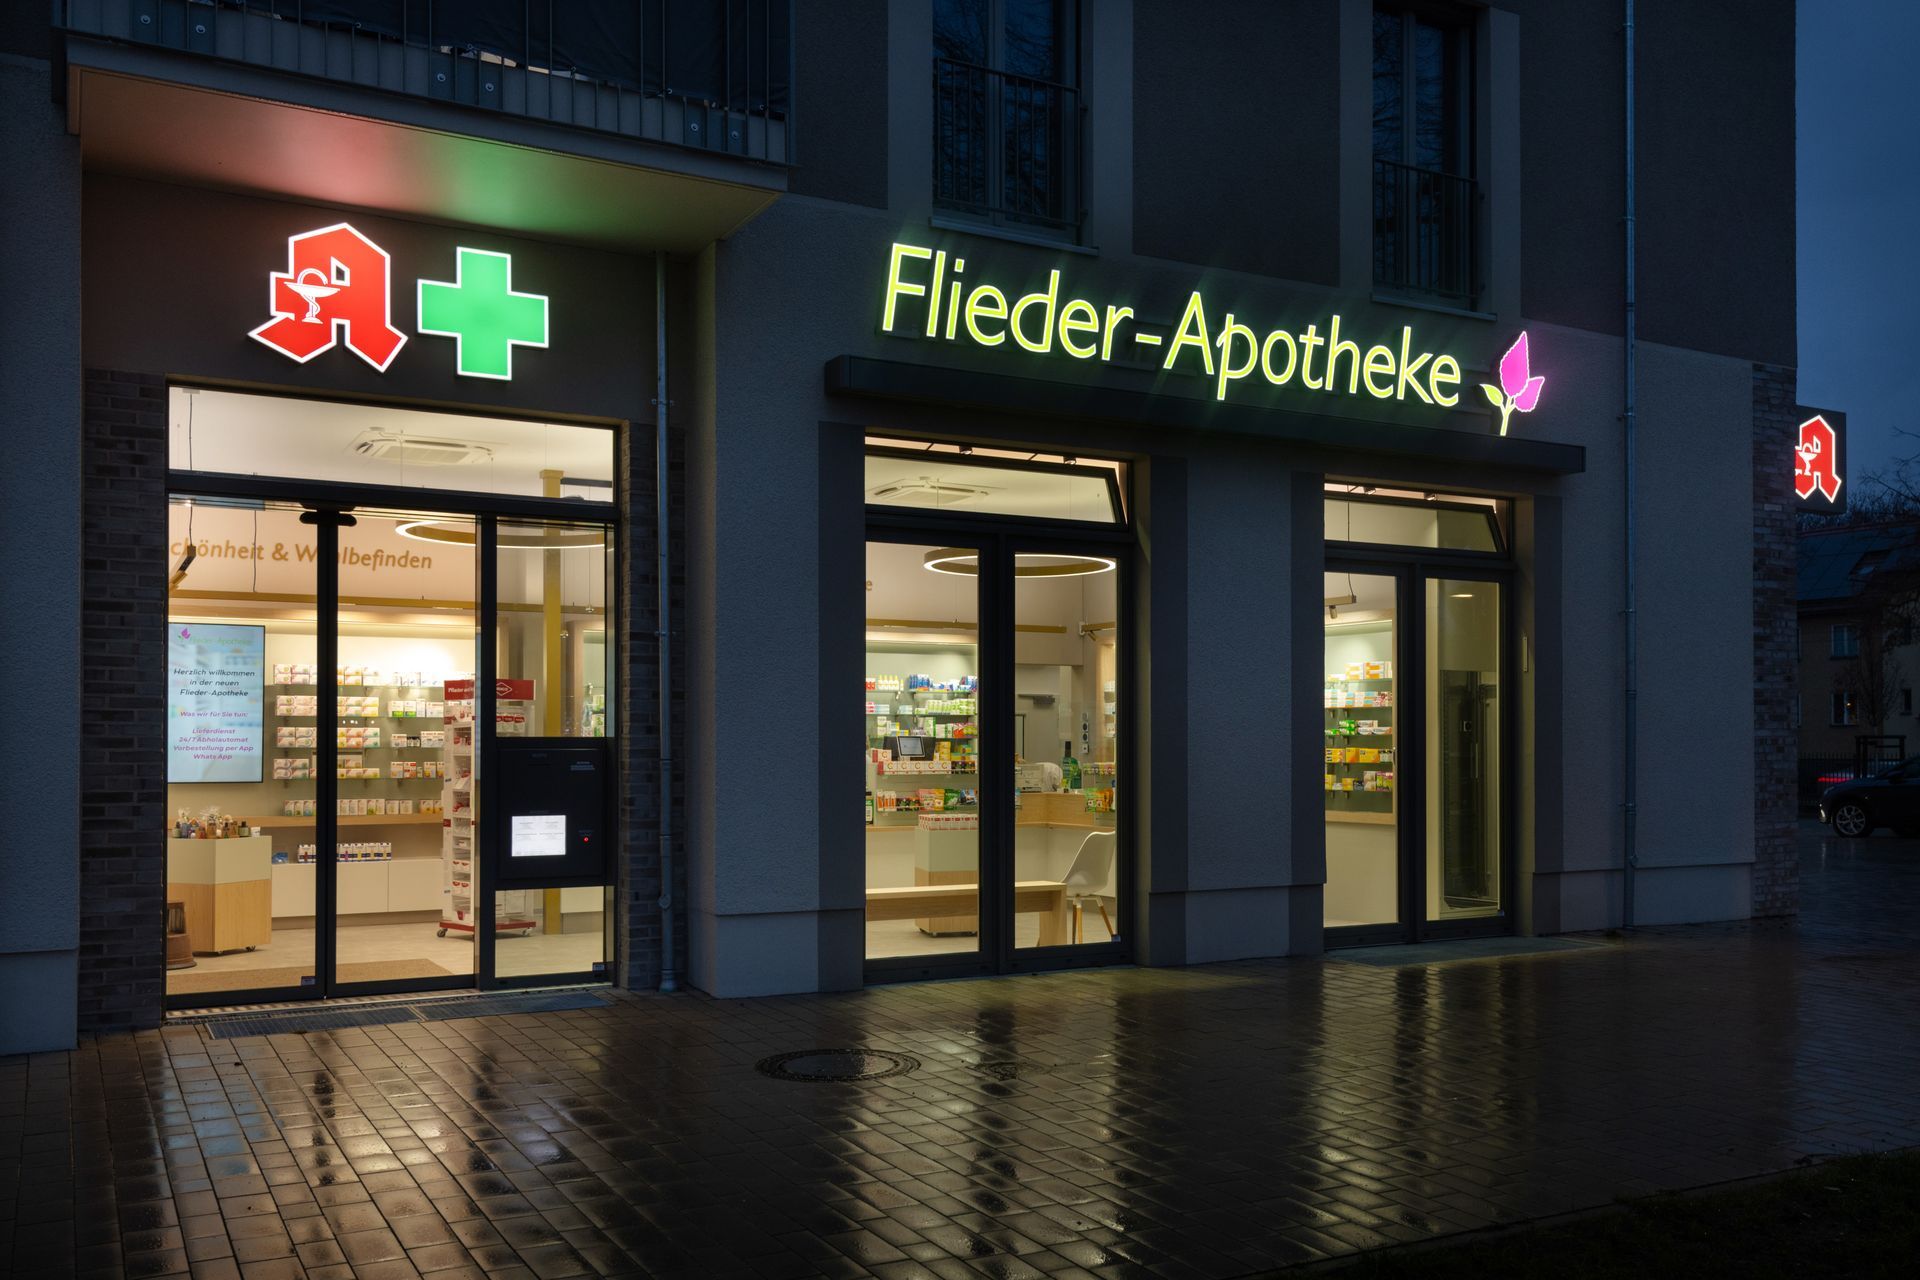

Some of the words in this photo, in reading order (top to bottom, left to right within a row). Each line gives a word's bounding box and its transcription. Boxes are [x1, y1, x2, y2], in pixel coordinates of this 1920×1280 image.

[882, 242, 1461, 407] Flieder-Apotheke
[271, 544, 288, 561] &
[173, 668, 207, 676] Herzlich
[208, 669, 255, 677] willkommen
[180, 689, 248, 697] Flieder-Apotheke
